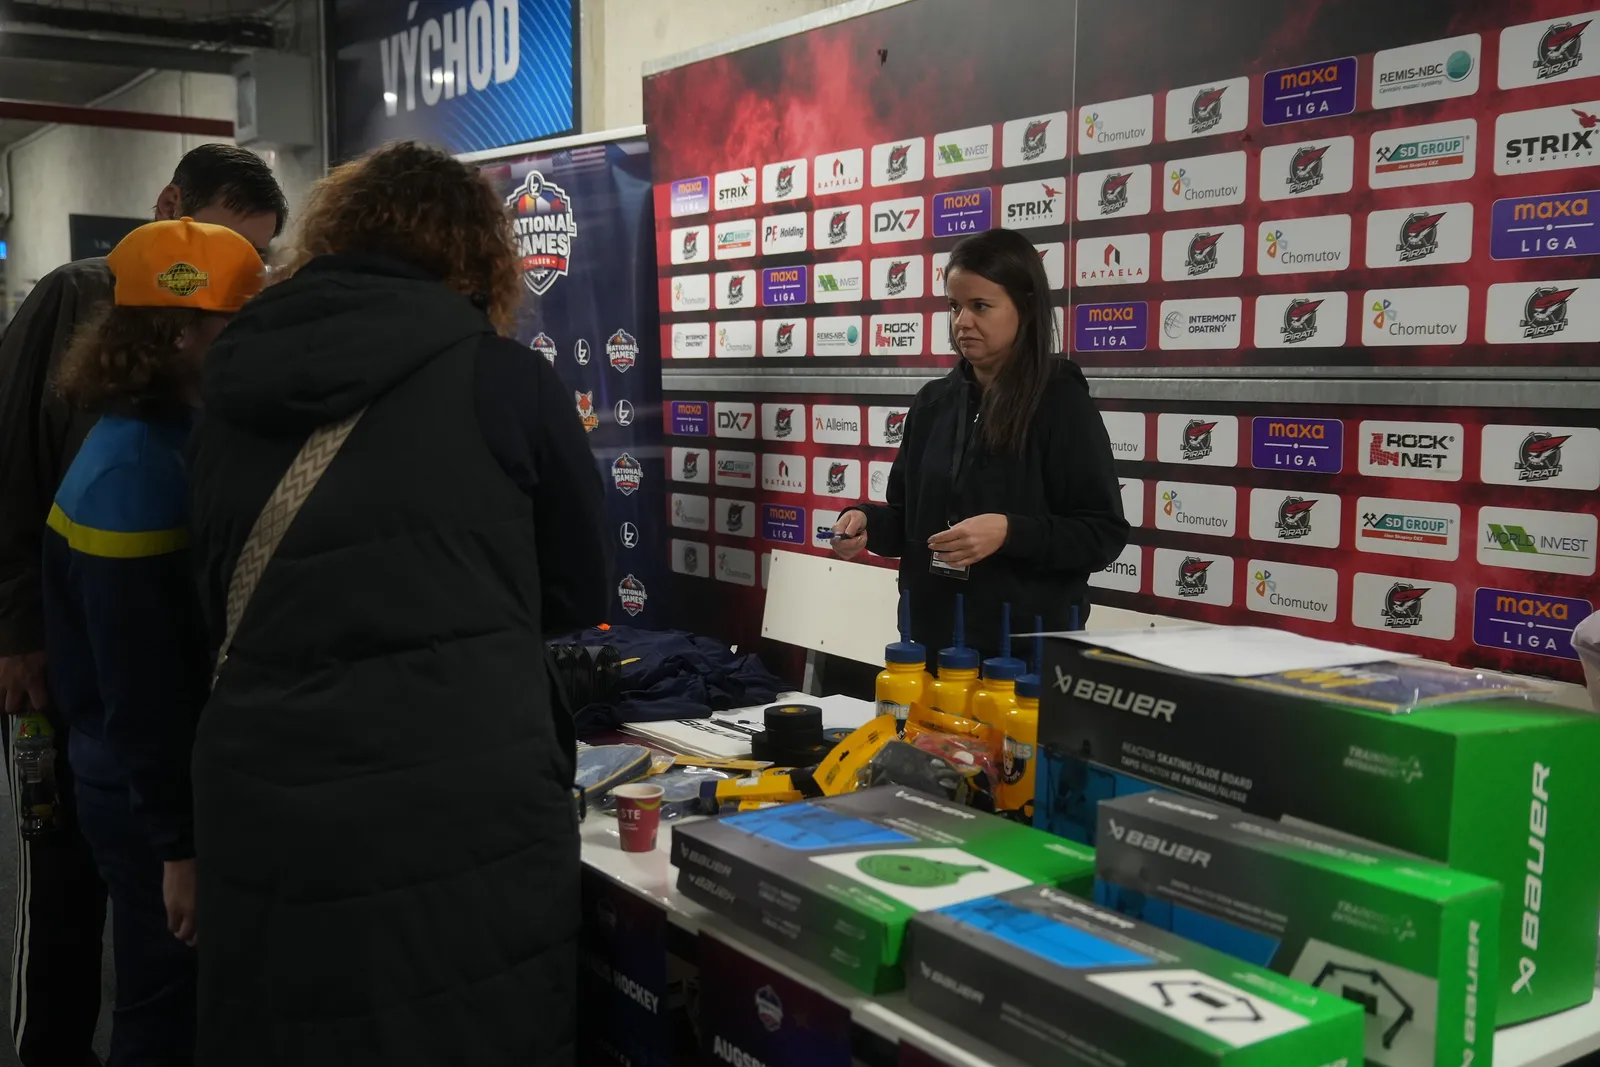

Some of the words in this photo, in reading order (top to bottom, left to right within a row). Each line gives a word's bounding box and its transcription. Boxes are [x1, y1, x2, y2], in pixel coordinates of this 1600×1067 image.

[381, 0, 520, 117] VÝCHOD
[1280, 65, 1338, 90] maxa
[1379, 63, 1443, 83] REMIS-NBC
[1286, 100, 1329, 117] LIGA
[1098, 128, 1146, 143] Chomutov
[965, 144, 989, 156] INVEST
[1400, 146, 1415, 158] SD
[1420, 140, 1460, 155] GROUP
[1506, 129, 1593, 158] STRIX
[1506, 151, 1592, 165] CHOMUTOV
[678, 180, 702, 192] maxa
[818, 177, 859, 189] RATAELA
[719, 185, 748, 200] STRIX
[1184, 186, 1238, 200] Chomutov
[944, 193, 980, 209] maxa
[1007, 199, 1053, 218] STRIX
[1514, 198, 1589, 221] maxa
[513, 213, 576, 235] ATIONAL
[875, 209, 920, 233] DX7
[948, 220, 975, 232] LIGA
[780, 226, 804, 238] Holding
[1521, 237, 1577, 252] LIGA
[1281, 251, 1341, 264] Chomutov
[770, 269, 799, 283] maxa
[1081, 267, 1143, 279] RATAELA
[839, 276, 859, 287] INVEST
[774, 292, 796, 302] LIGA
[1089, 307, 1134, 322] maxa
[1188, 314, 1237, 324] INTERMONT
[884, 322, 915, 333] ROCK
[1188, 323, 1227, 333] OPATRNÝ
[1389, 322, 1457, 336] Chomutov
[817, 331, 846, 341] REMIS-NBC
[891, 336, 915, 347] NET
[1094, 336, 1127, 346] LIGA
[606, 344, 639, 353] NATIONAL
[610, 352, 635, 360] GAMES
[678, 405, 702, 415] maxa
[681, 424, 700, 433] LIGA
[718, 411, 752, 432] DX7
[826, 419, 858, 432] Alleima
[1269, 422, 1325, 439] maxa
[1111, 442, 1138, 452] mutov
[1387, 433, 1449, 450] ROCK
[1275, 453, 1317, 467] LIGA
[1401, 452, 1447, 469] NET
[612, 467, 643, 477] NATIONAL
[615, 474, 639, 483] GAMES
[765, 478, 802, 488] RATAELA
[769, 508, 797, 521] maxa
[1176, 512, 1228, 528] Chomutov
[1385, 517, 1402, 528] SD
[1406, 519, 1445, 532] GROUP
[772, 529, 794, 540] LIGA
[1486, 531, 1536, 547] WORLD
[1540, 536, 1589, 552] INVEST
[1107, 561, 1137, 576] eima
[619, 588, 647, 599] NATIONAL
[622, 595, 644, 604] GAMES
[1269, 593, 1328, 612] Chomutov
[1496, 596, 1569, 620] maxa
[1503, 631, 1558, 651] LIGA
[1220, 771, 1253, 790] BOARD
[613, 969, 660, 1015] HOCKEY
